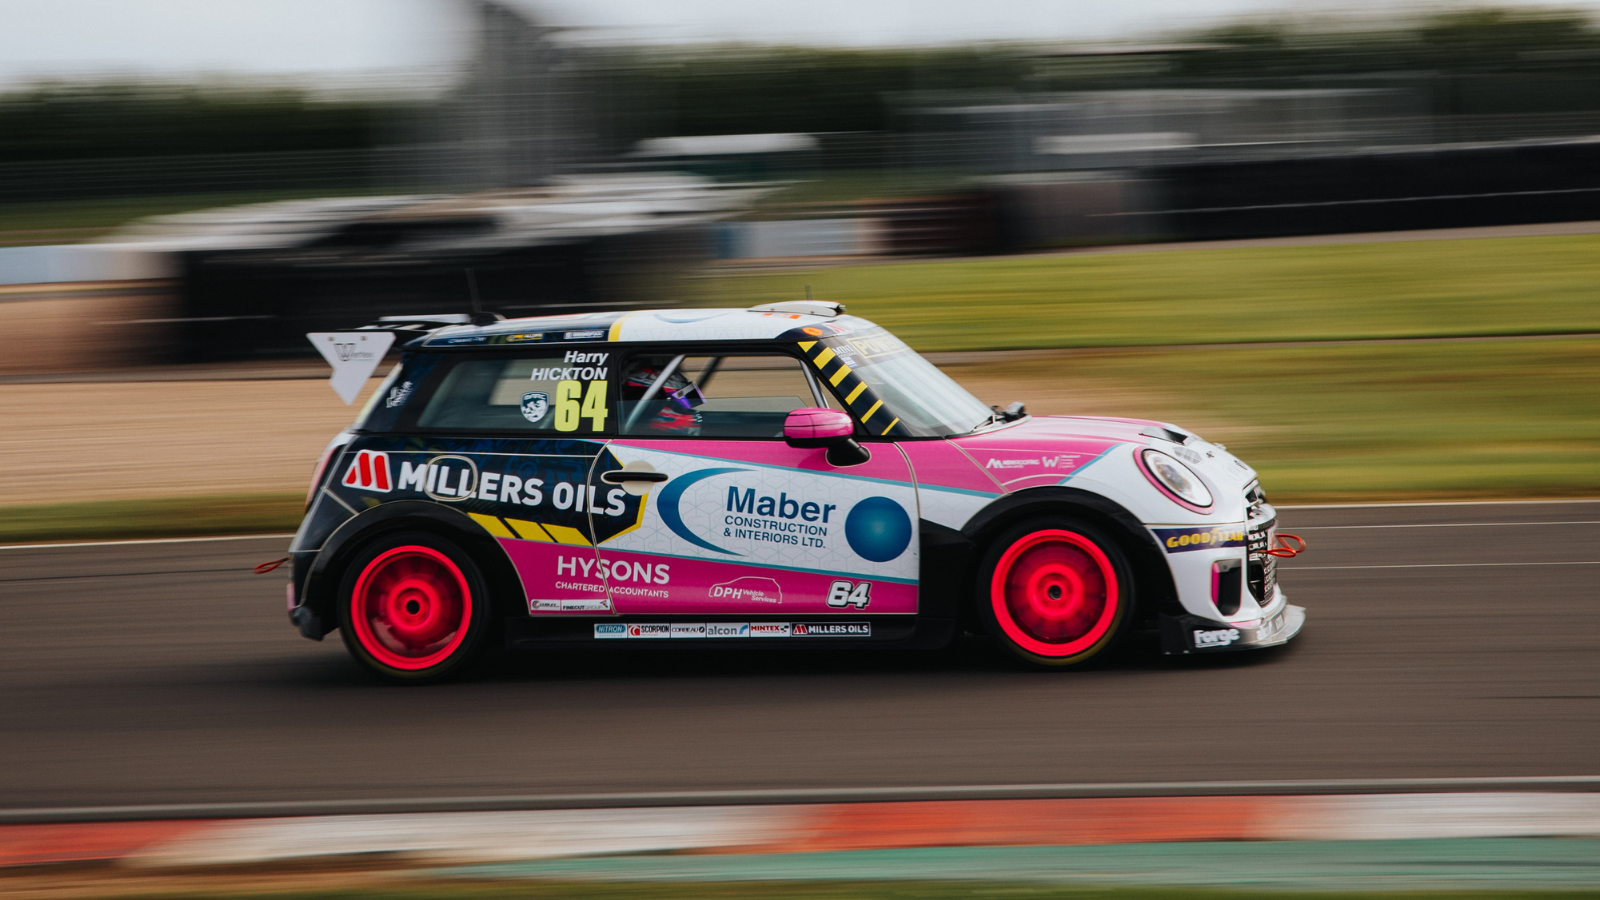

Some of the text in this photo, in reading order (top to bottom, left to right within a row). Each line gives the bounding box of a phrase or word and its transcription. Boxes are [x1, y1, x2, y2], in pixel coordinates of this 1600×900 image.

[564, 351, 609, 366] Harry
[531, 367, 608, 381] HICKTON
[554, 380, 609, 432] 64
[397, 461, 626, 517] MILLERS OILS
[726, 486, 837, 523] Maber
[724, 515, 828, 537] CONSTRUCTION
[723, 527, 826, 549] & INTERIORS LTD.
[557, 555, 671, 585] HYSONS
[555, 581, 669, 598] CHARTERED ACCOUNTANTS
[713, 586, 764, 600] DPH Vehicle
[827, 580, 871, 610] 64
[751, 595, 777, 603] Services
[598, 625, 623, 633] NITRON
[641, 625, 669, 634] SCORPION
[707, 626, 738, 636] alcon
[808, 625, 869, 634] MILLERS OILS
[1193, 628, 1240, 648] Forge
